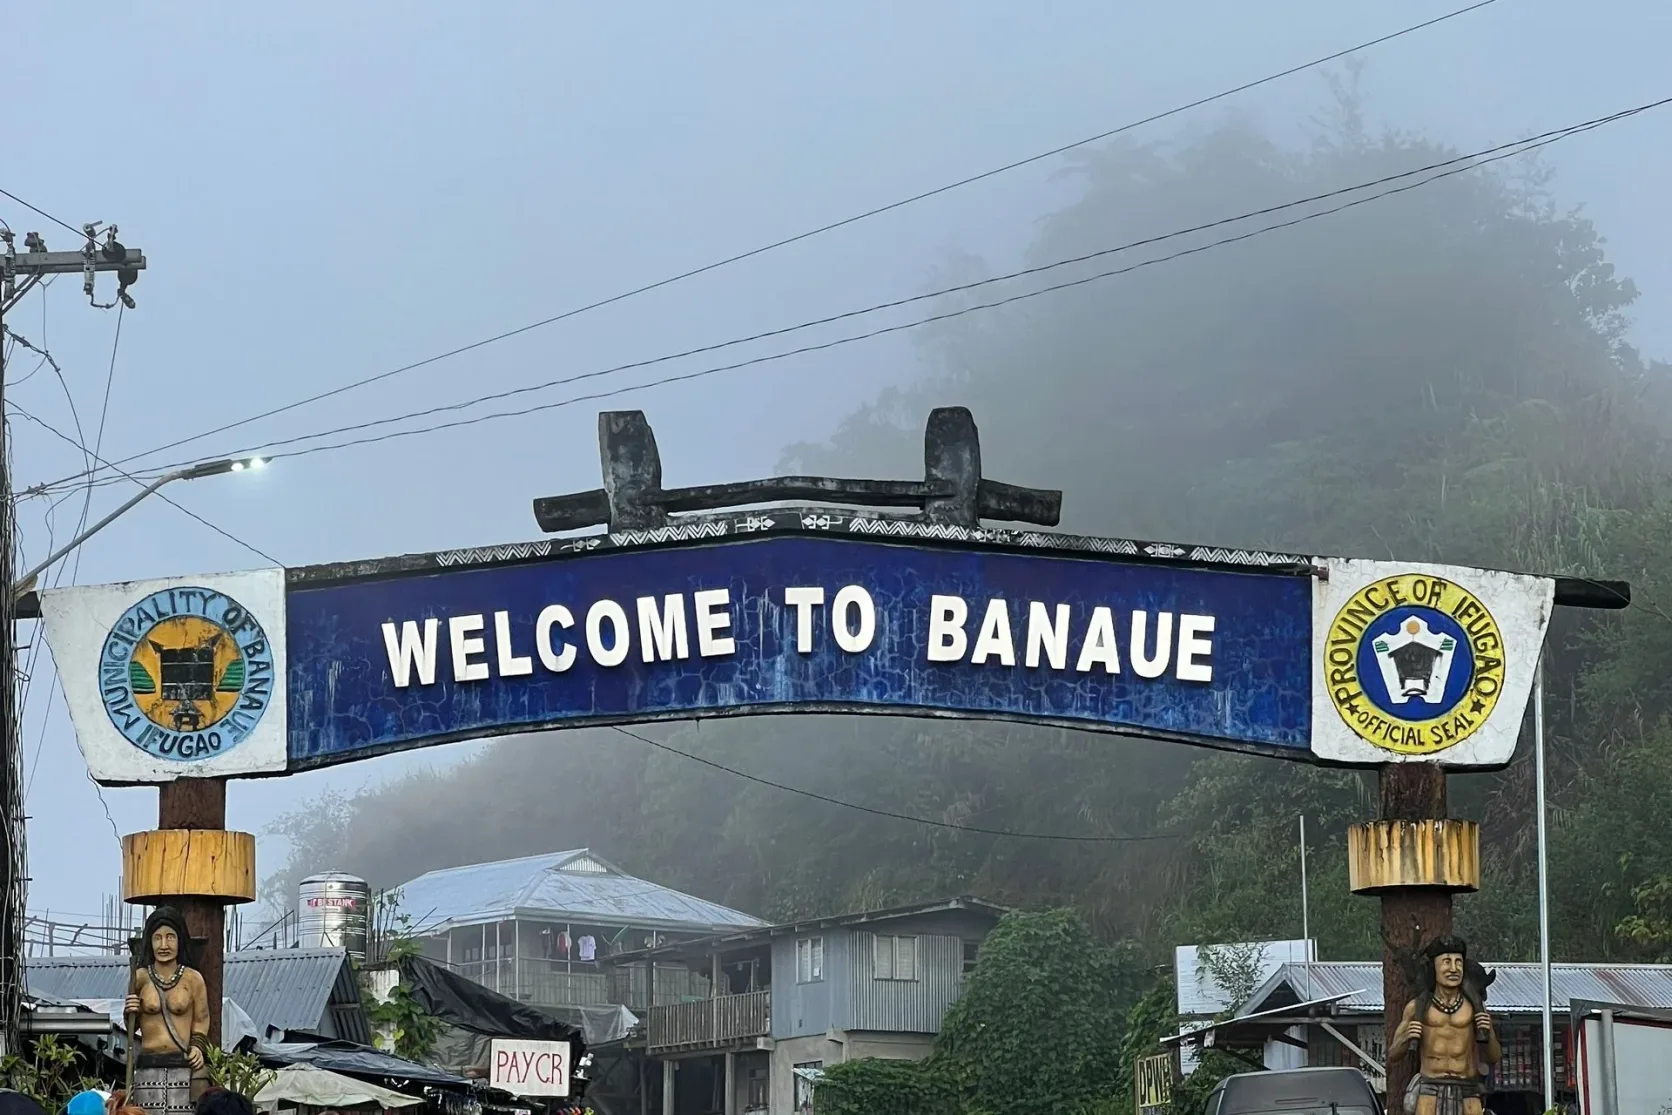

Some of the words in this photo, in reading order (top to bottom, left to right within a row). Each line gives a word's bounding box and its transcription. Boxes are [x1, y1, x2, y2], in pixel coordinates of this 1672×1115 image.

[103, 590, 217, 730] MUNICIPALITY
[221, 602, 257, 637] OF
[381, 588, 736, 688] WELCOME
[785, 584, 876, 653] TO
[927, 594, 1216, 682] BANAUE
[1329, 580, 1407, 708] PROVINCE
[1412, 579, 1447, 609] OF
[1452, 596, 1502, 699] IFUGAO
[137, 724, 222, 758] IFUGAO
[220, 636, 271, 742] BANAUE
[1357, 711, 1425, 745] OFFICIAL
[1430, 714, 1474, 745] SEAL
